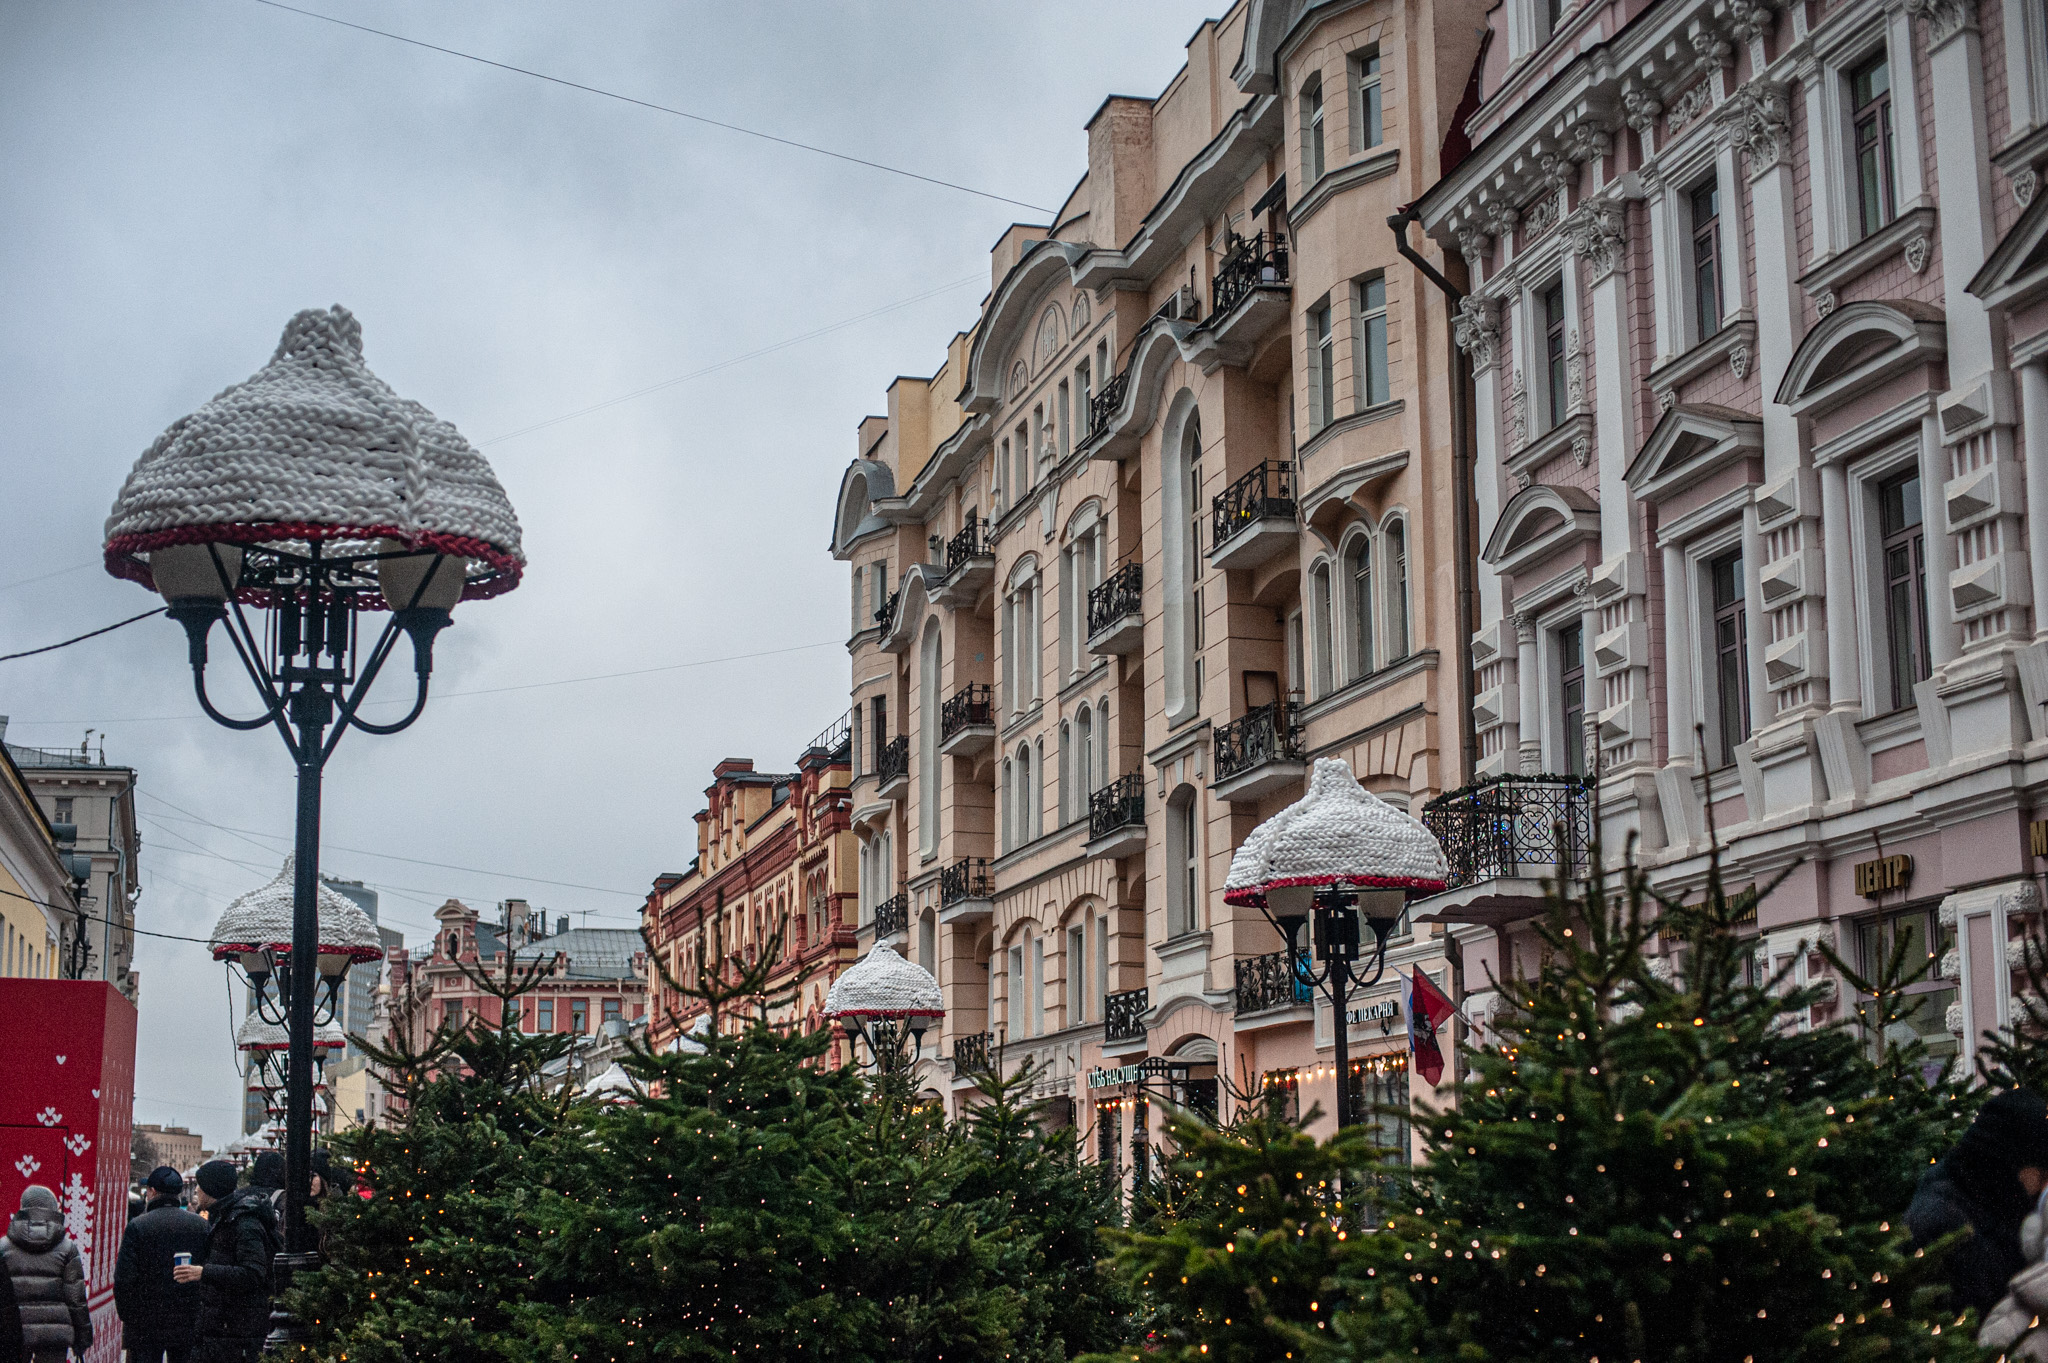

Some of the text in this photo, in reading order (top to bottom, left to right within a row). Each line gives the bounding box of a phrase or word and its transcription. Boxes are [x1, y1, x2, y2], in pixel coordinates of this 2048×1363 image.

[1854, 854, 1908, 899] ЦЕНТР
[1346, 1002, 1394, 1025] ФЕ ПЕКАРНЯ
[1106, 1063, 1146, 1086] НАСУЩН
